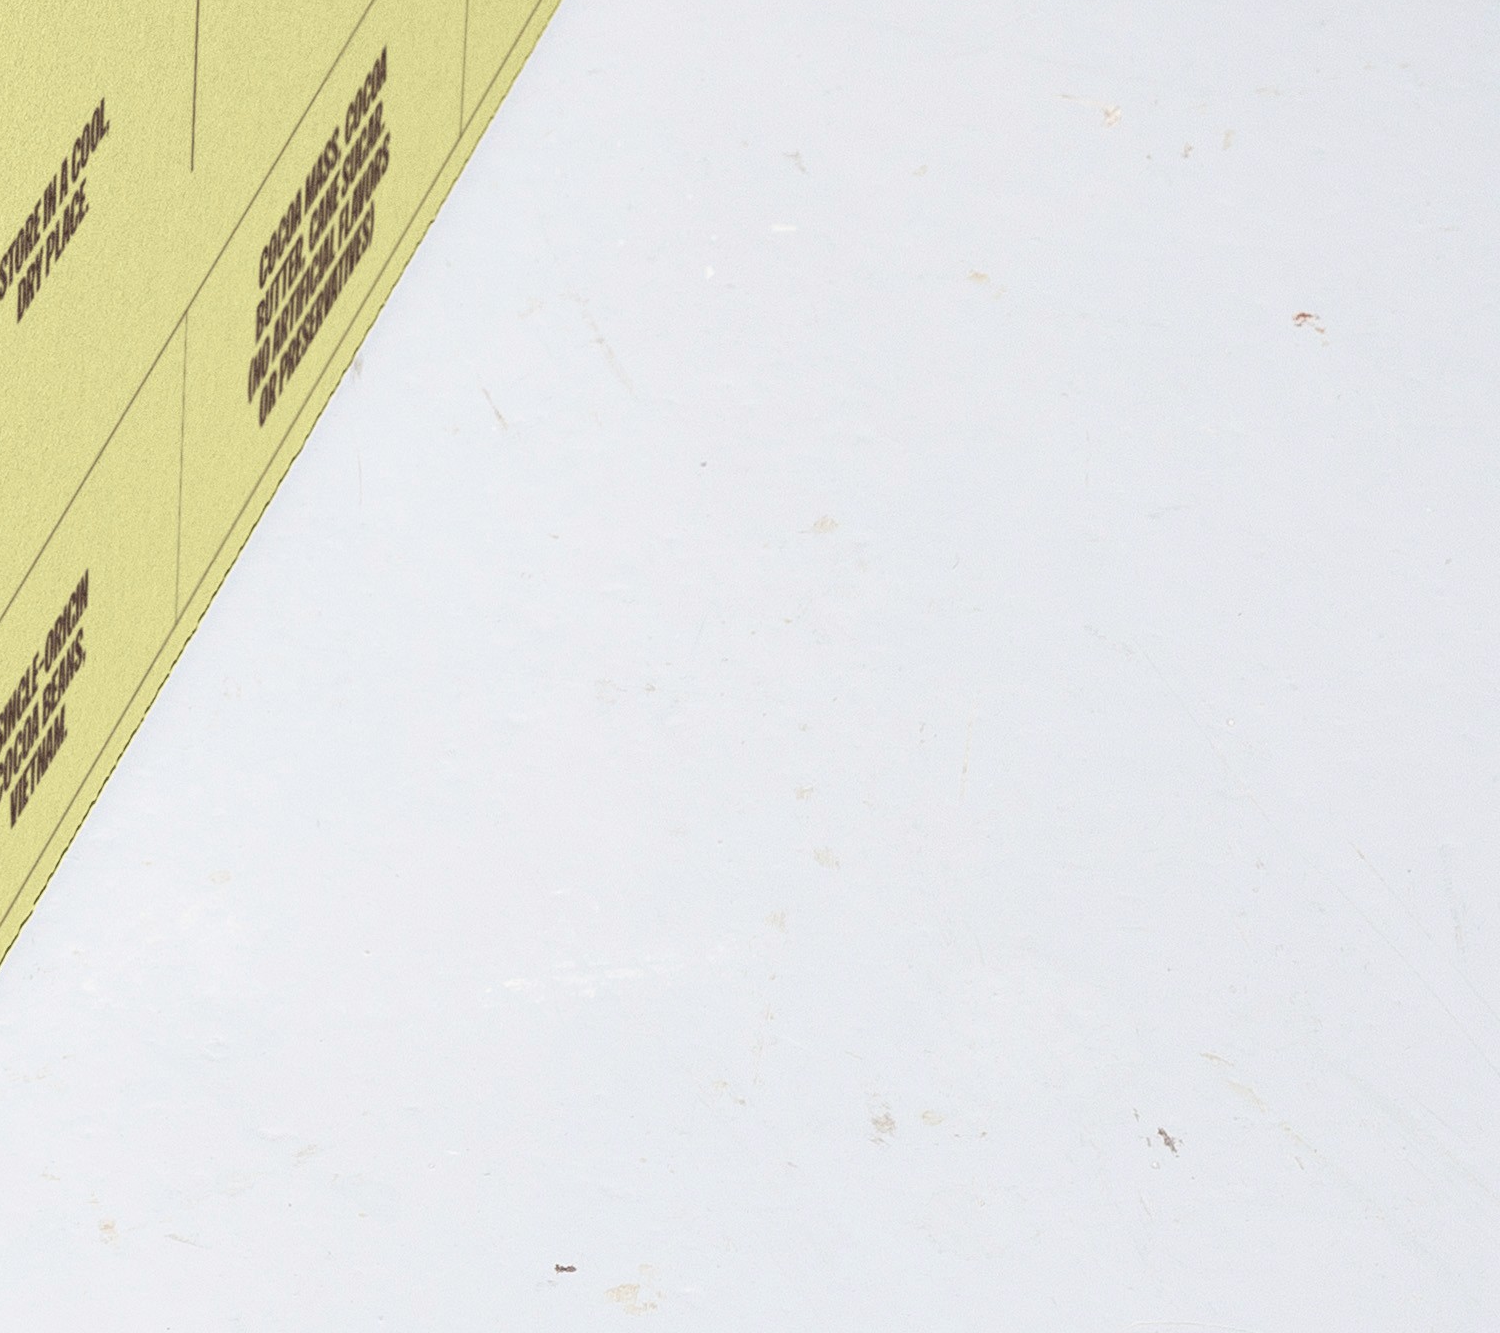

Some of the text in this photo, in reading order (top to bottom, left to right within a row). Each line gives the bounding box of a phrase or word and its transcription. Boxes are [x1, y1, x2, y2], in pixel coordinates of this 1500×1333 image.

[0, 200, 41, 300] STORE
[43, 175, 57, 230] IN
[59, 158, 68, 204] A
[259, 190, 302, 289] COCOA
[345, 47, 387, 144] COCOA
[309, 171, 340, 251] CANE
[17, 179, 89, 322] DRY PLACE.
[248, 133, 390, 402] (NO ARTIFICIAL FLAVORS
[259, 202, 374, 427] OR PRESERVATIVES)
[10, 705, 67, 828] VIETNAM.
